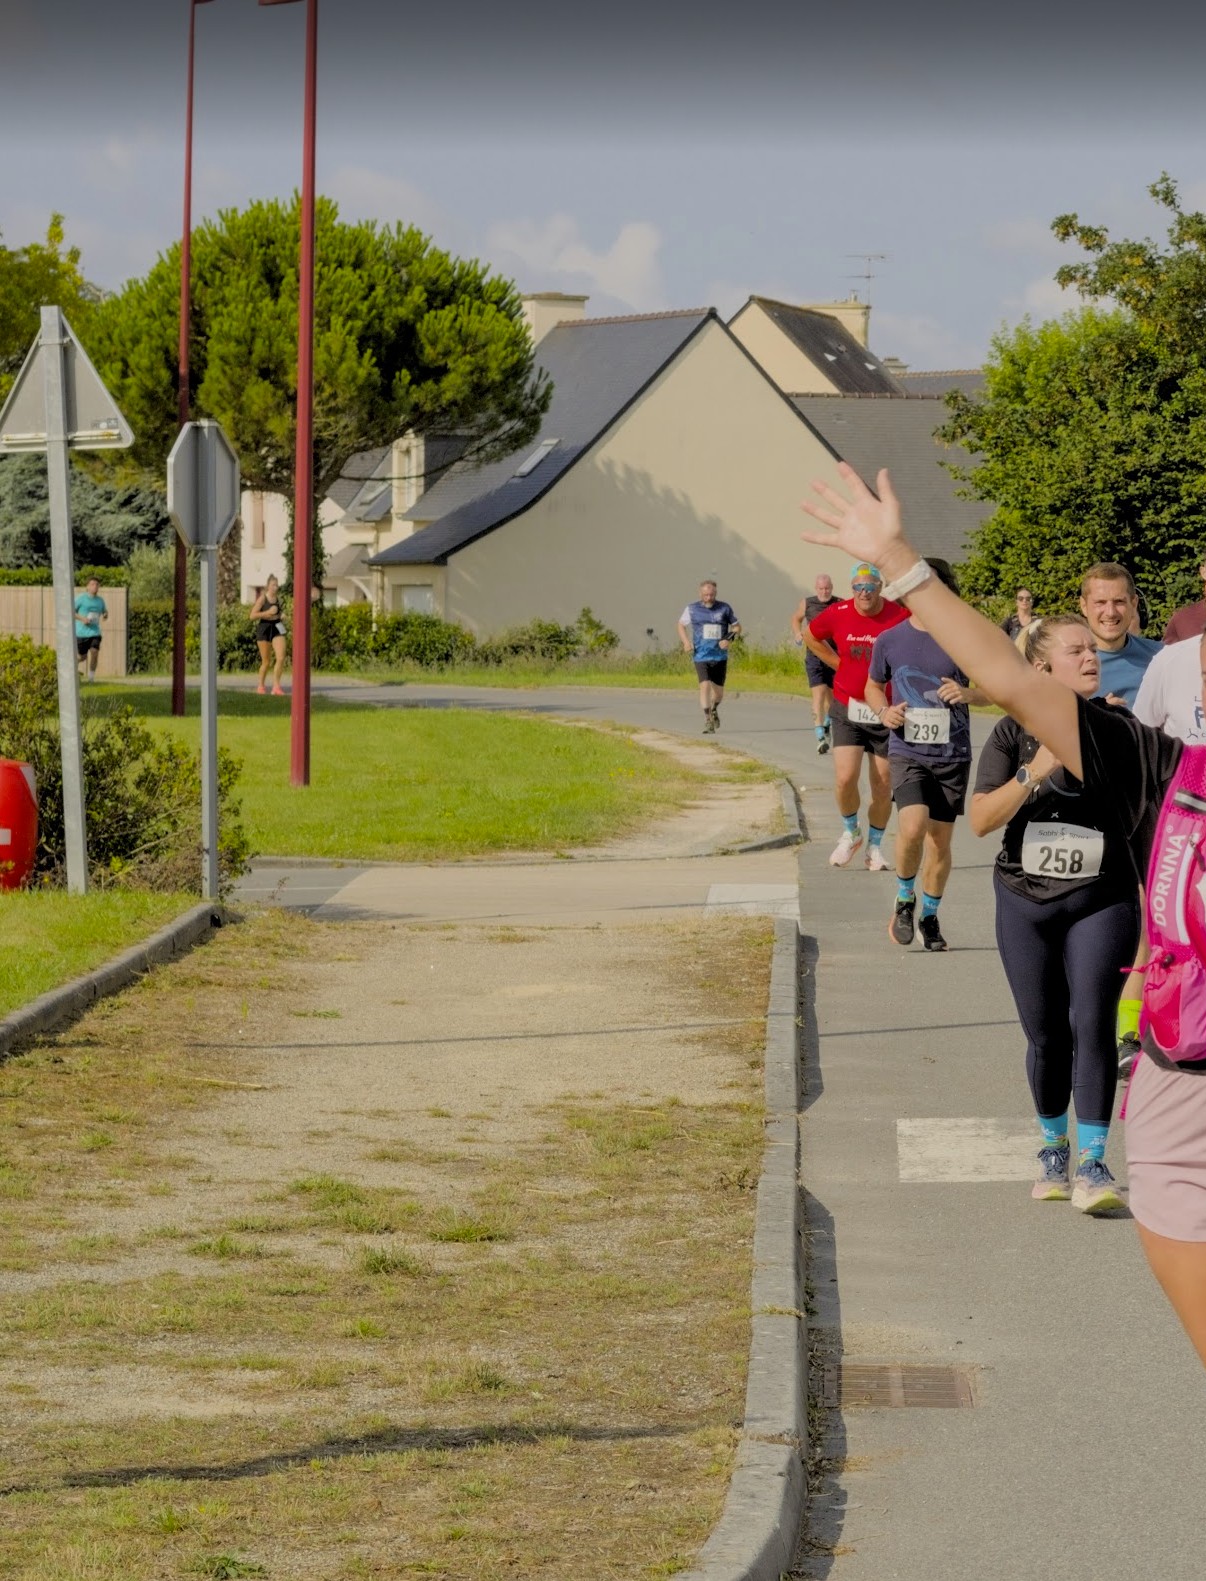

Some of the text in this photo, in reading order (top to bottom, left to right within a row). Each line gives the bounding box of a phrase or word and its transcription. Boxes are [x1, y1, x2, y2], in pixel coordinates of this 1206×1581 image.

[913, 723, 939, 741] 239
[1038, 845, 1084, 875] 258
[1153, 834, 1187, 928] DORNNA
